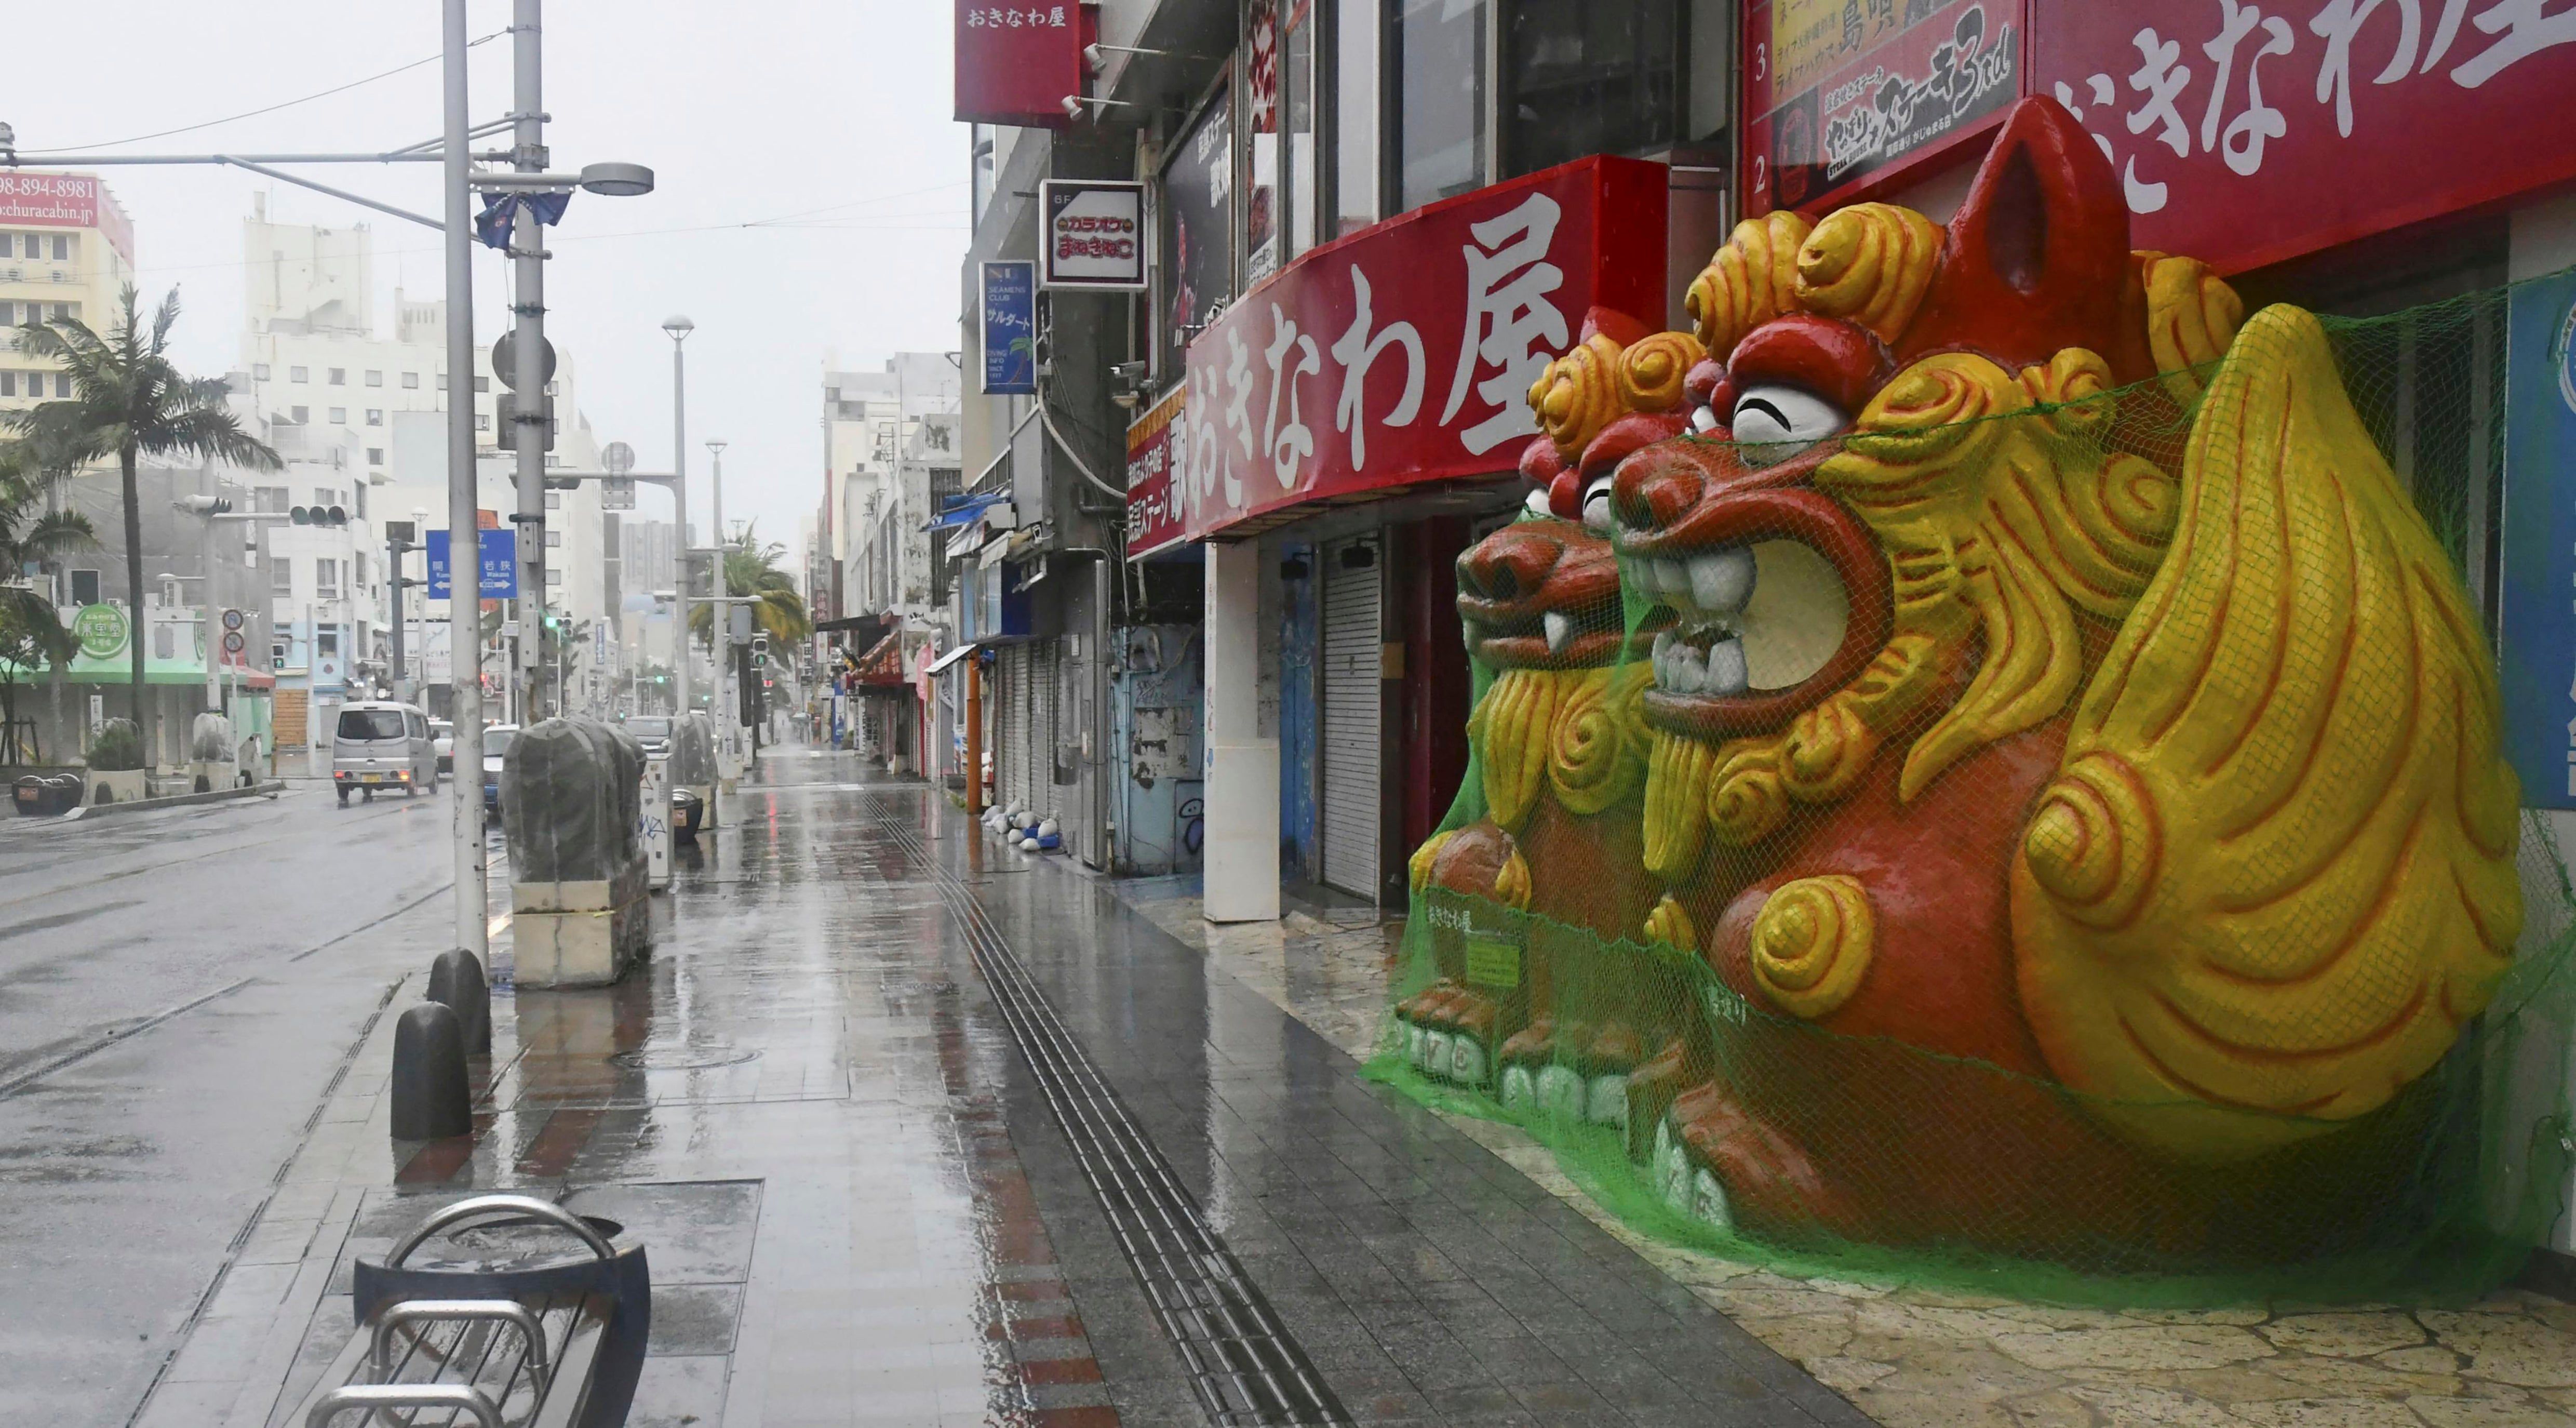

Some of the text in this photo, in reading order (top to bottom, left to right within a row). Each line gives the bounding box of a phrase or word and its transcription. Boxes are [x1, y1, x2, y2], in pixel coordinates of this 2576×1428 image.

[967, 6, 1066, 28] おきなわ屋
[1755, 43, 1766, 82] 3
[1754, 155, 1766, 194] 2
[1829, 157, 1847, 177] STEAK
[1054, 194, 1071, 204] 6F
[1067, 216, 1123, 233] カラオケ
[1057, 234, 1134, 260] まねきねこ
[1186, 191, 1569, 520] おきなわ屋
